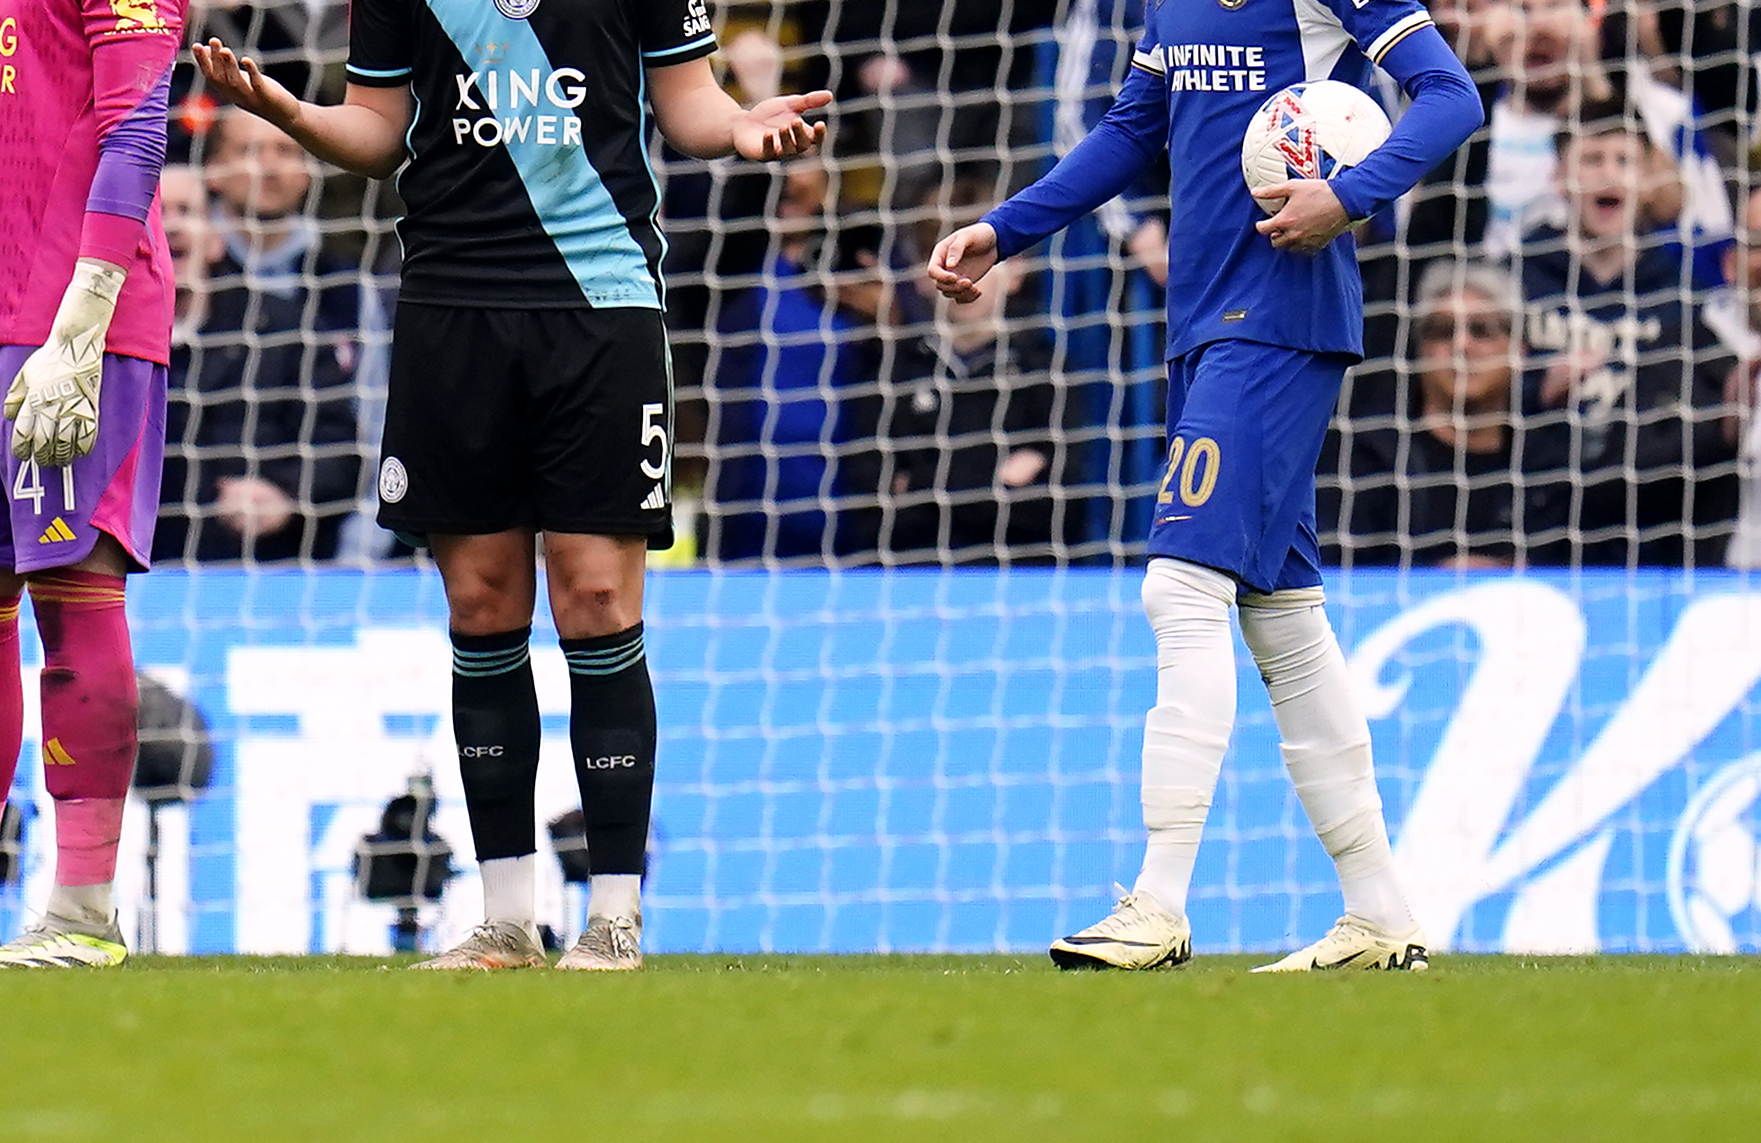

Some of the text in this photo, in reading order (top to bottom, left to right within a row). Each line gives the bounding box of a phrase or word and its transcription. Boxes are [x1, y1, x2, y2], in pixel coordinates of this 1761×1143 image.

[1168, 44, 1265, 67] INFINITE
[455, 67, 587, 111] KING
[1171, 69, 1266, 92] ATHLETE
[452, 116, 583, 147] POWER
[640, 403, 668, 479] 5
[1157, 436, 1221, 507] 20
[586, 755, 636, 769] LCFC
